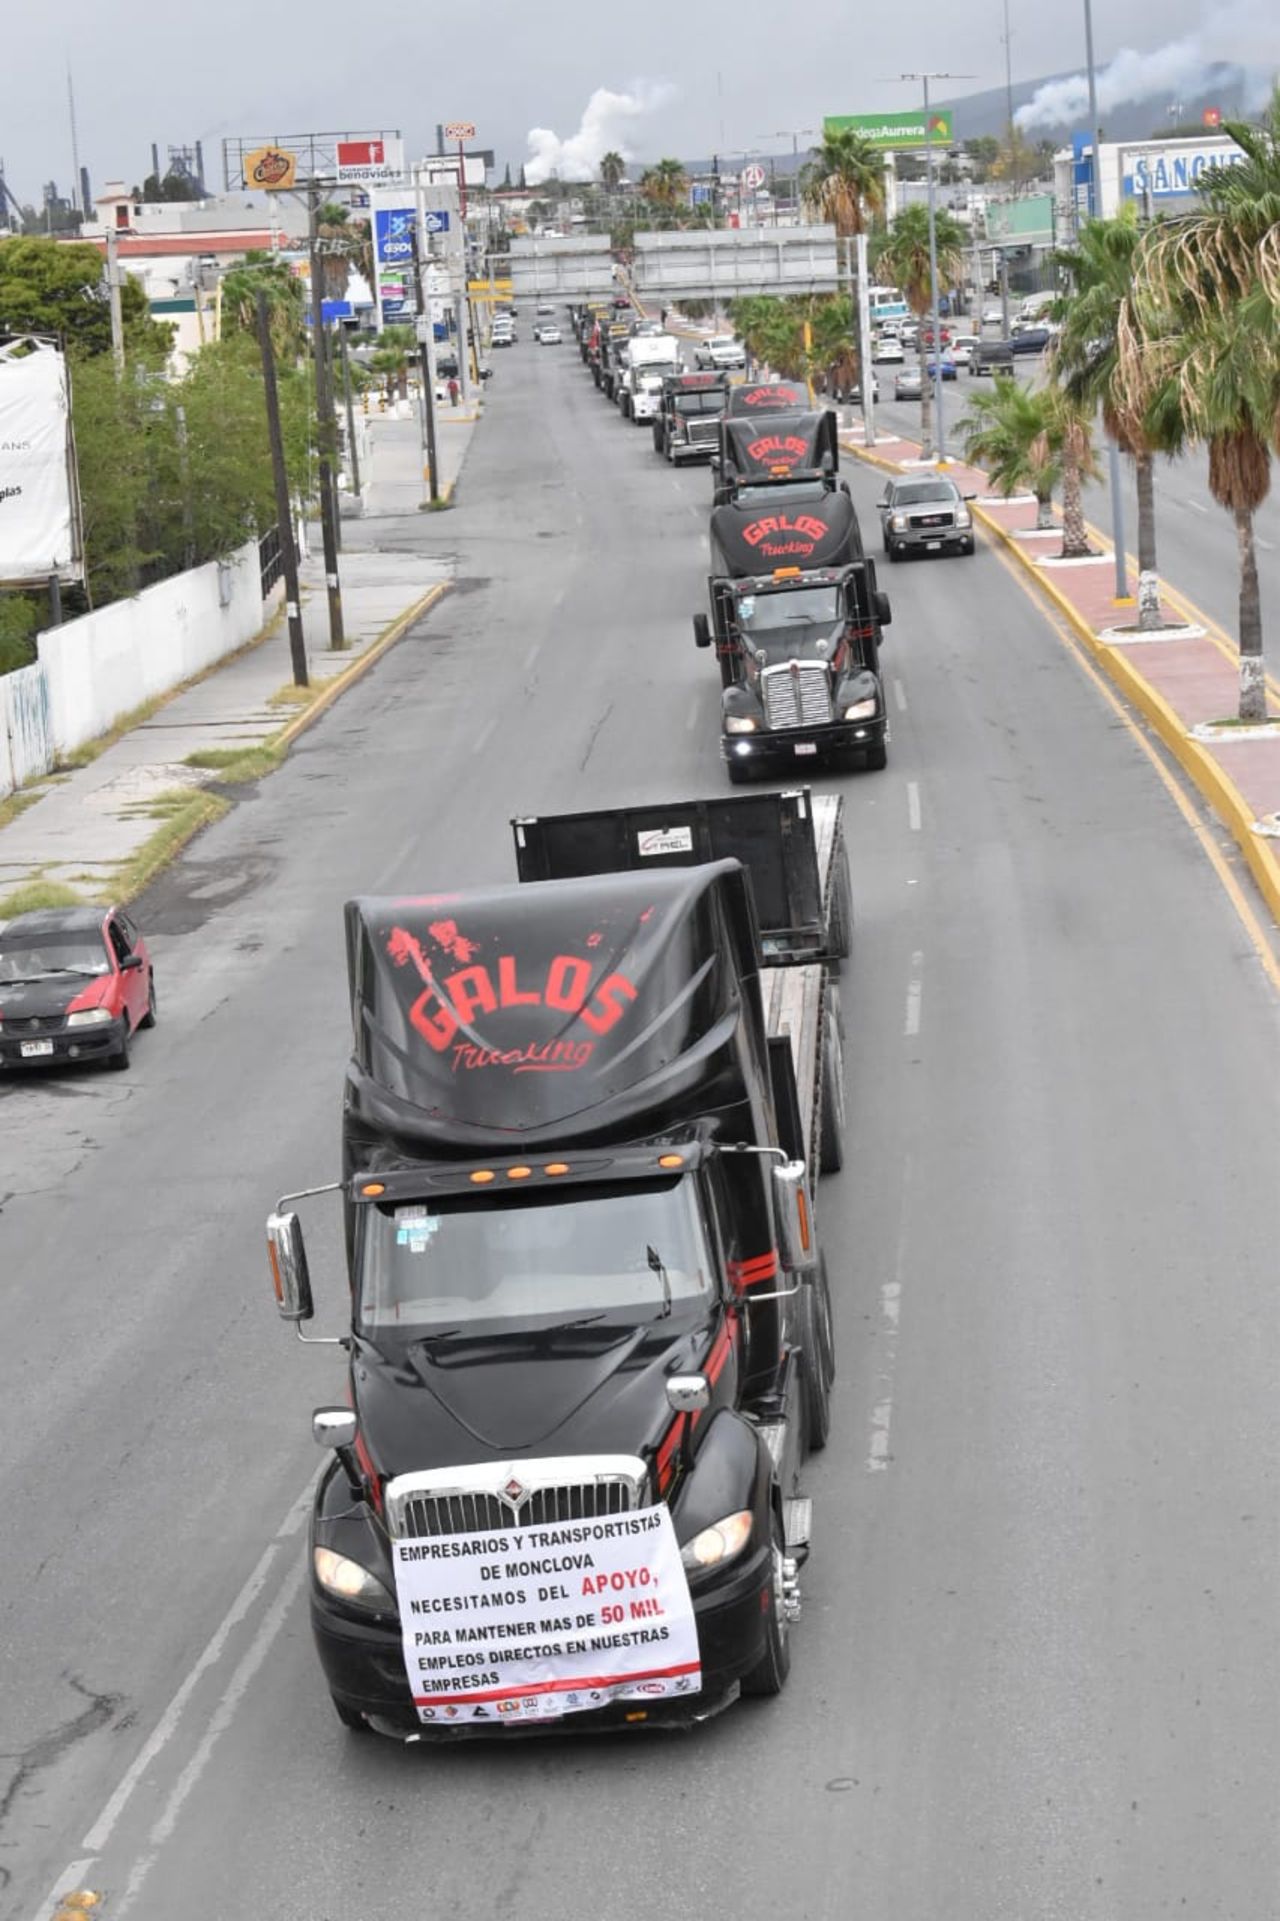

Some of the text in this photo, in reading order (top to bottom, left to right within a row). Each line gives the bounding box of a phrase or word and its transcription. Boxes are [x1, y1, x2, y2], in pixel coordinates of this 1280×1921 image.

[744, 386, 798, 405] GALOS
[747, 435, 808, 460] GALOS
[742, 513, 829, 546] GALOS
[760, 541, 815, 559] Trucking
[409, 955, 639, 1052] GALOS
[400, 1512, 661, 1561] EMPRESARIOS Y TRANSPORTISTAS
[481, 1553, 594, 1580] DE MONCLOVA
[411, 1567, 658, 1615] NECESITAMOS DEL APOYO,
[415, 1598, 664, 1646] PARA MANTENER MAS DE 50 MIL
[419, 1627, 670, 1670] EMPLEOS DIRECTOS EN NUESTRAS
[423, 1671, 500, 1692] EMPRESAS
